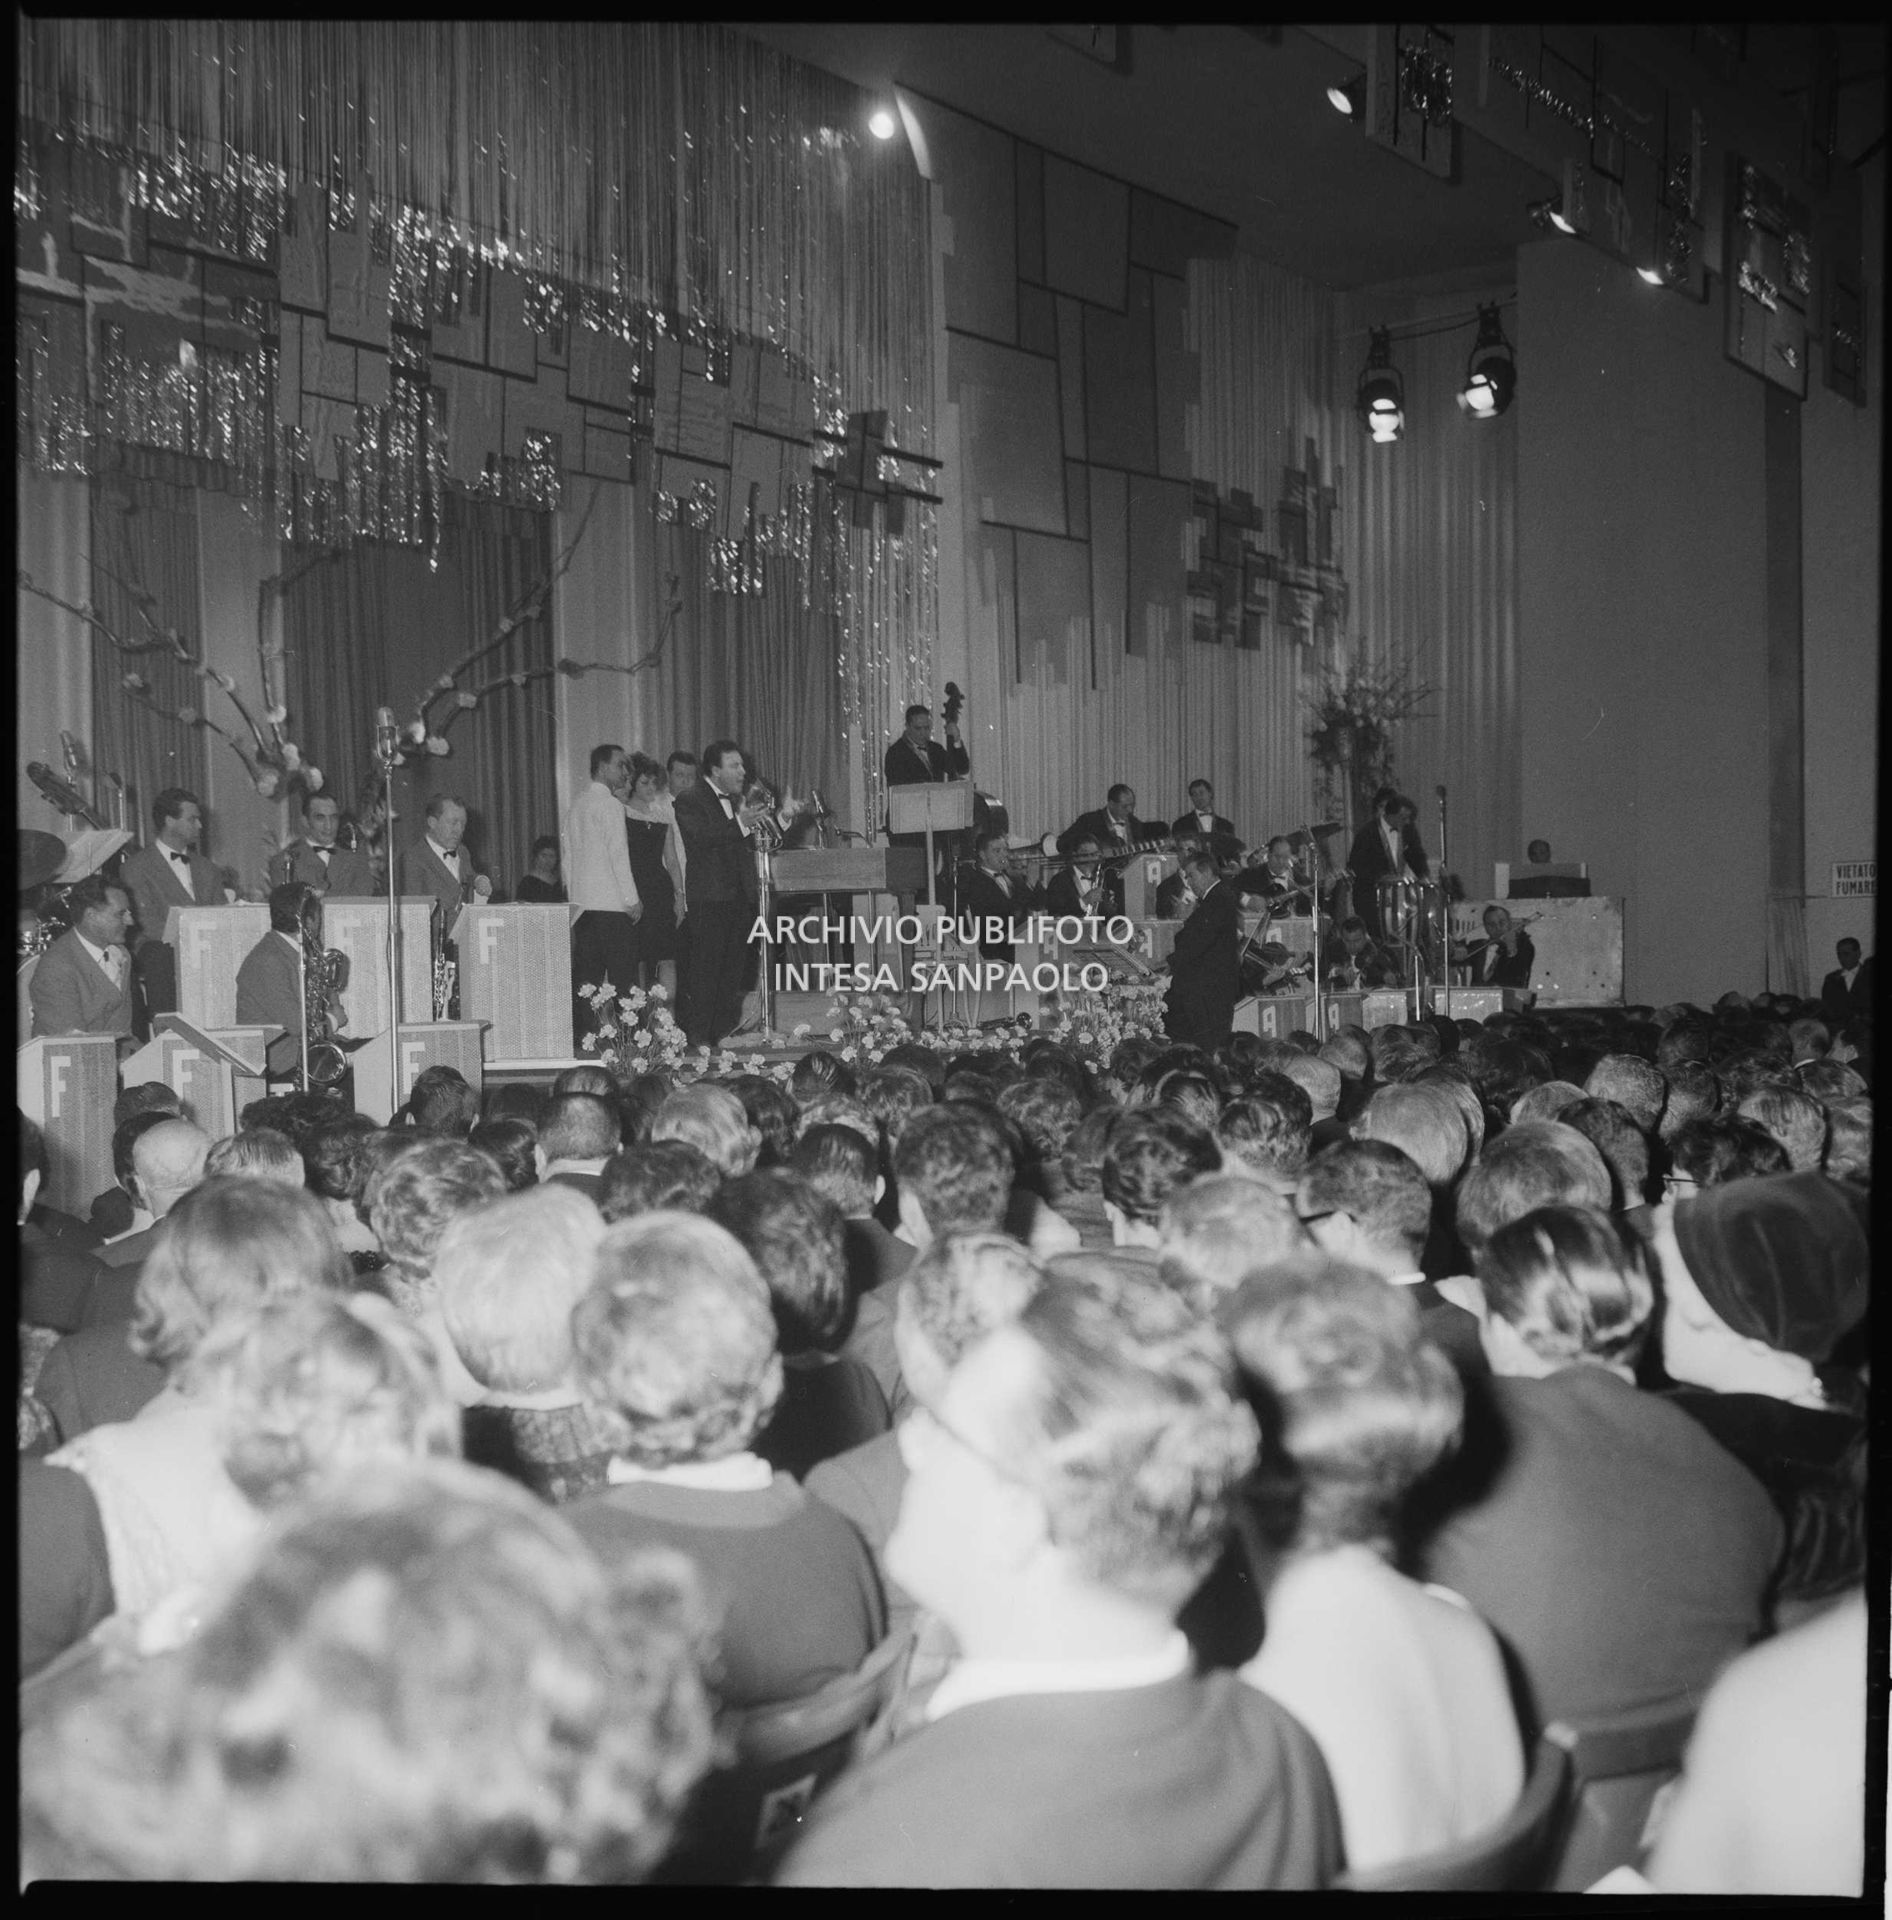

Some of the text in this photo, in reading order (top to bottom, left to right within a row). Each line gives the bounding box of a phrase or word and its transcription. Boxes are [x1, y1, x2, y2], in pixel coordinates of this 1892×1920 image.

[1147, 861, 1161, 887] A
[1837, 865, 1877, 879] VIETATO
[193, 920, 217, 967] F
[336, 918, 361, 963] F
[478, 917, 504, 965] F
[1263, 1005, 1277, 1038] A
[1328, 1003, 1340, 1031] A
[50, 1055, 71, 1118] F
[172, 1049, 199, 1101] F
[403, 1041, 426, 1095] F
